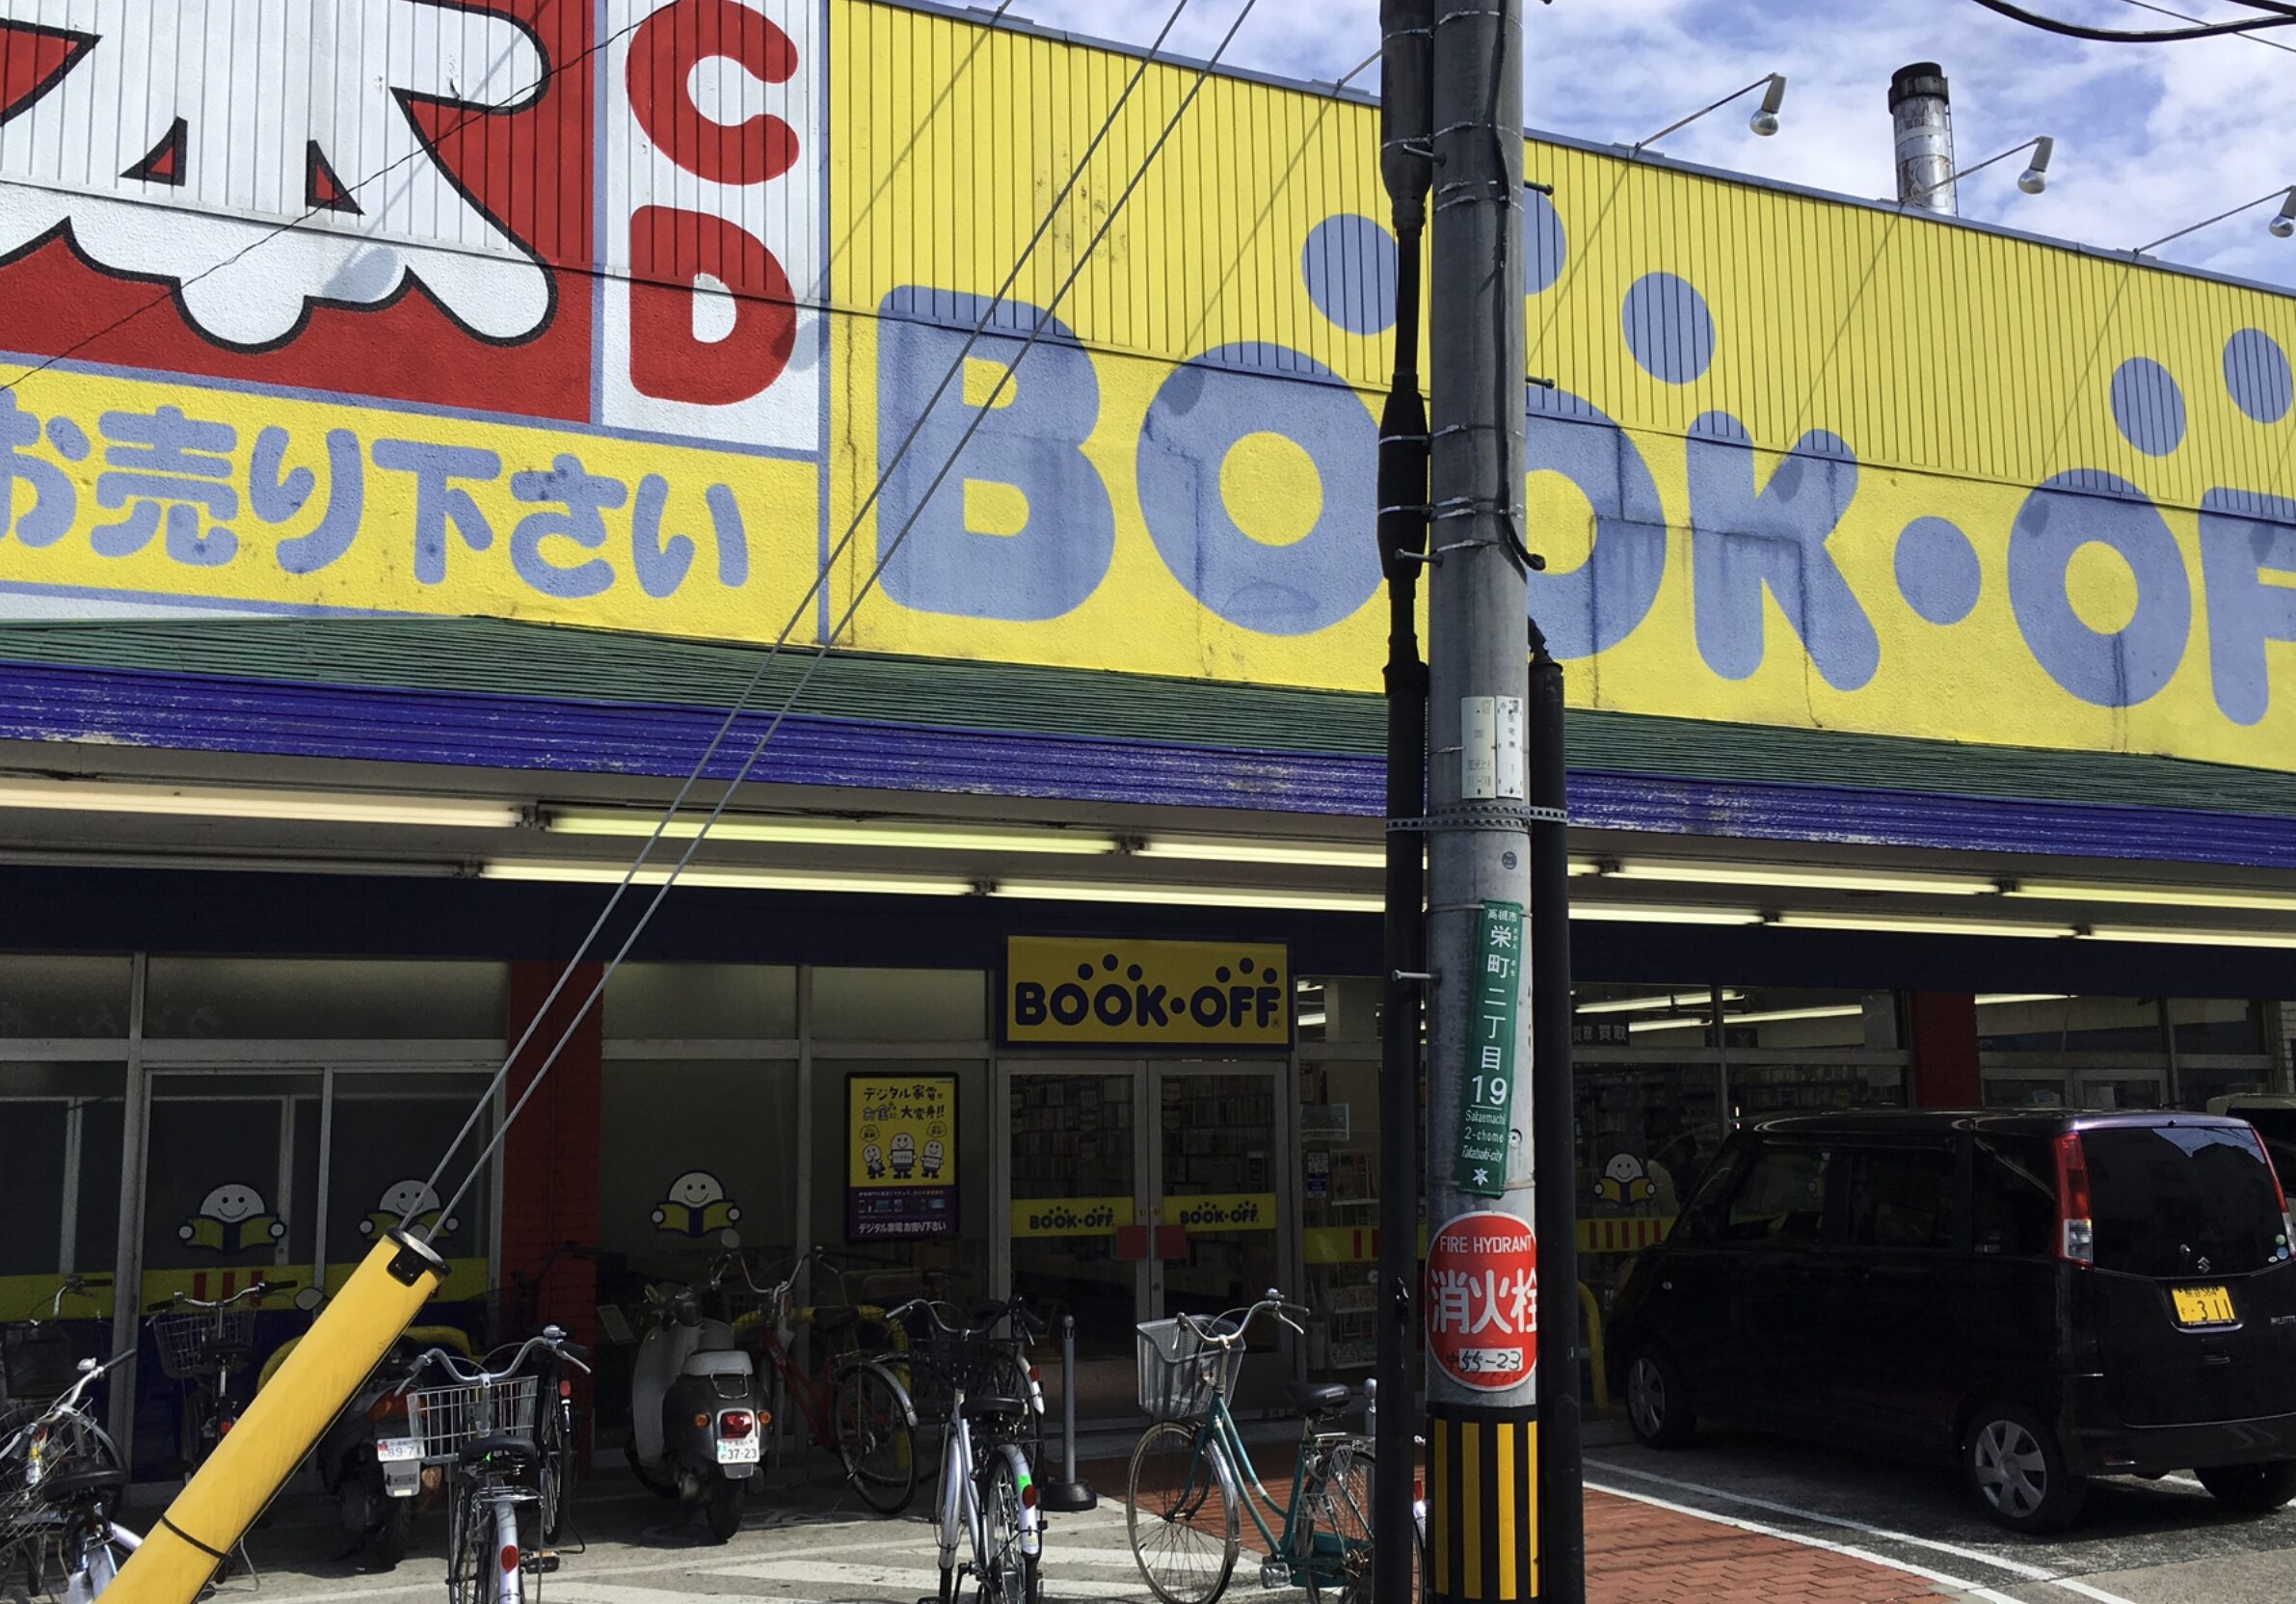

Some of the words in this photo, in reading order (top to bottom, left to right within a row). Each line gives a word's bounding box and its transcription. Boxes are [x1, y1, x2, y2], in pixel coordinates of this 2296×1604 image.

[0, 392, 749, 599] お売り下さい
[1487, 908, 1517, 922] 高槻市
[1481, 925, 1511, 1071] 栄町二丁目
[1472, 1075, 1508, 1105] 19
[1465, 1109, 1506, 1126] Sakaemachi
[1464, 1126, 1504, 1143] 2-chome
[1439, 1235, 1467, 1253] FIRE
[1473, 1235, 1532, 1253] HYDRANT
[1431, 1268, 1537, 1334] 消火栓
[728, 1448, 757, 1459] 37-23
